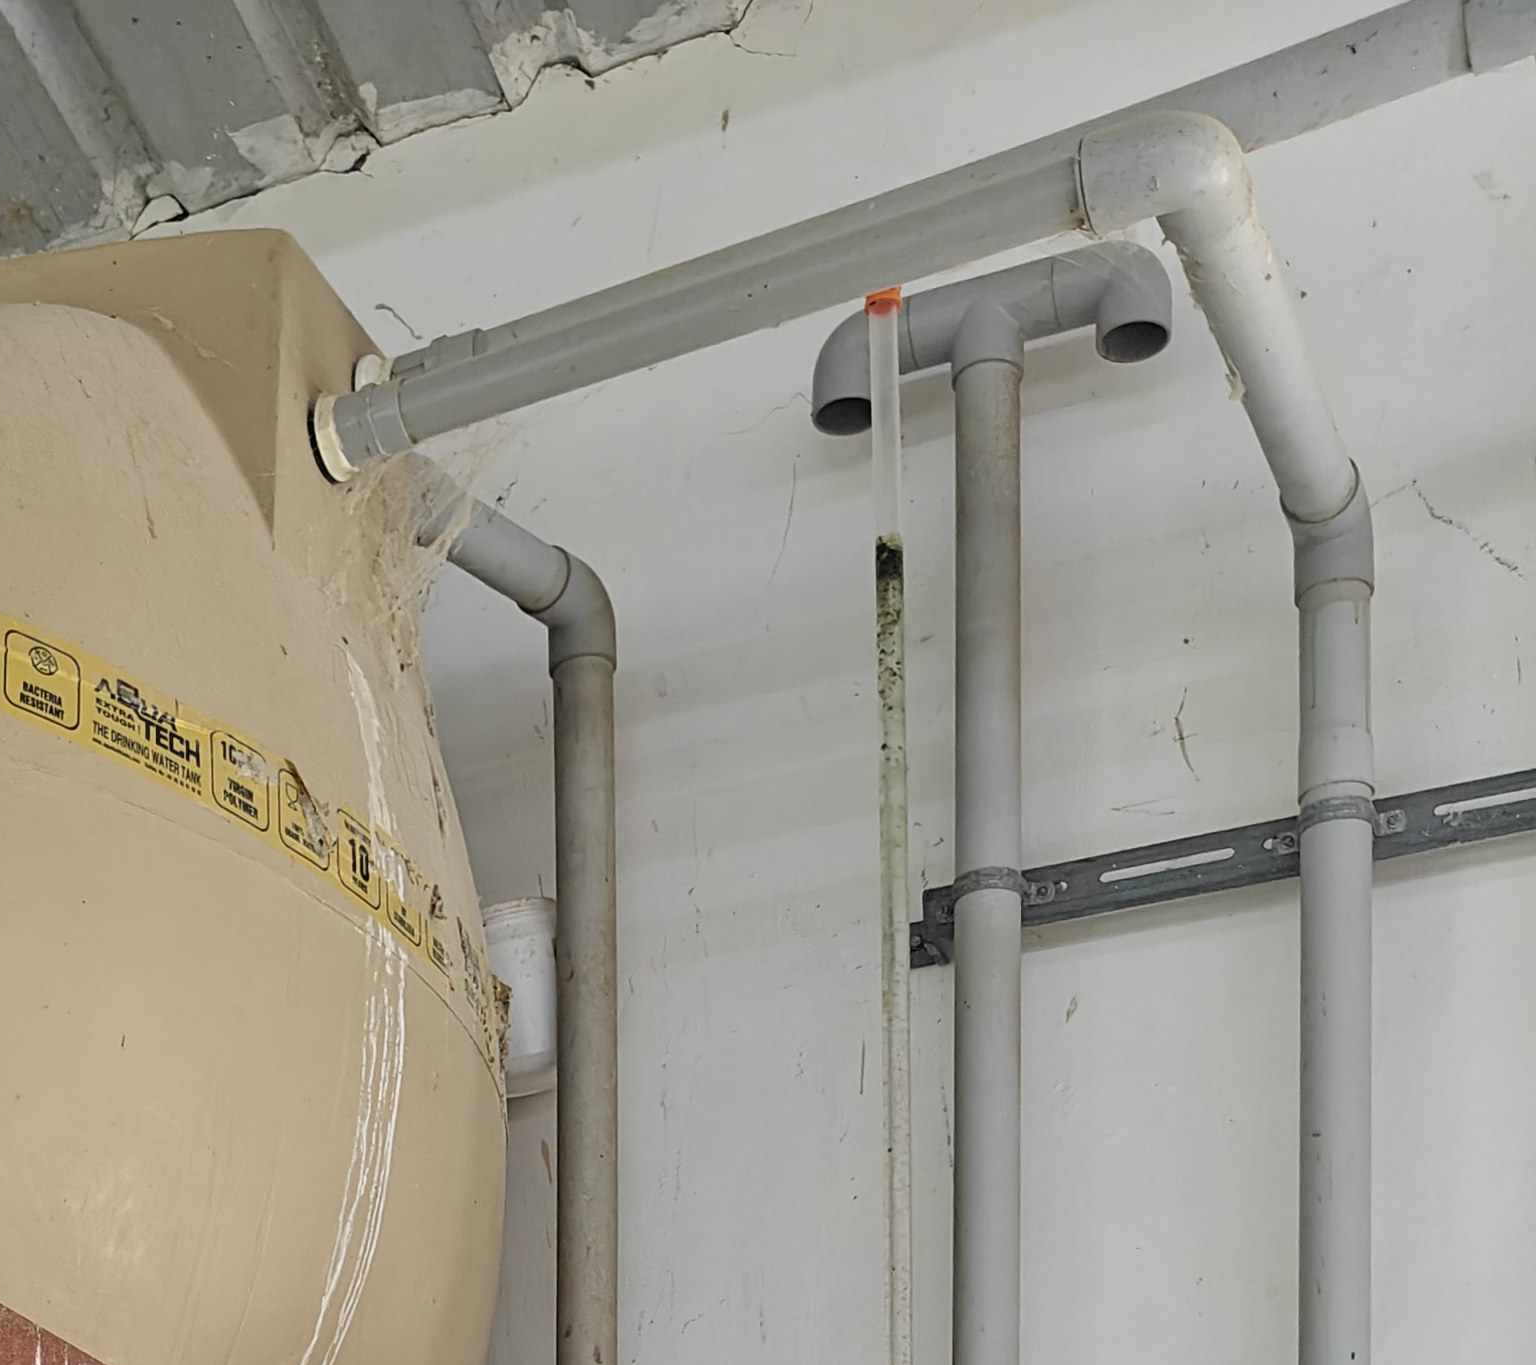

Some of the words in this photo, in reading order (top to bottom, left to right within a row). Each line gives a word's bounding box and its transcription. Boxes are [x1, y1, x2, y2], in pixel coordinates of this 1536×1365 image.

[19, 692, 65, 720] RESISTANT
[22, 681, 63, 708] BACTERIA
[95, 697, 135, 722] EXTRA
[92, 720, 110, 741] THE
[110, 729, 150, 760] DRINKING
[151, 749, 180, 777] WATER
[181, 764, 202, 788] TANK
[144, 719, 201, 768] TECH
[349, 838, 369, 882] 10
